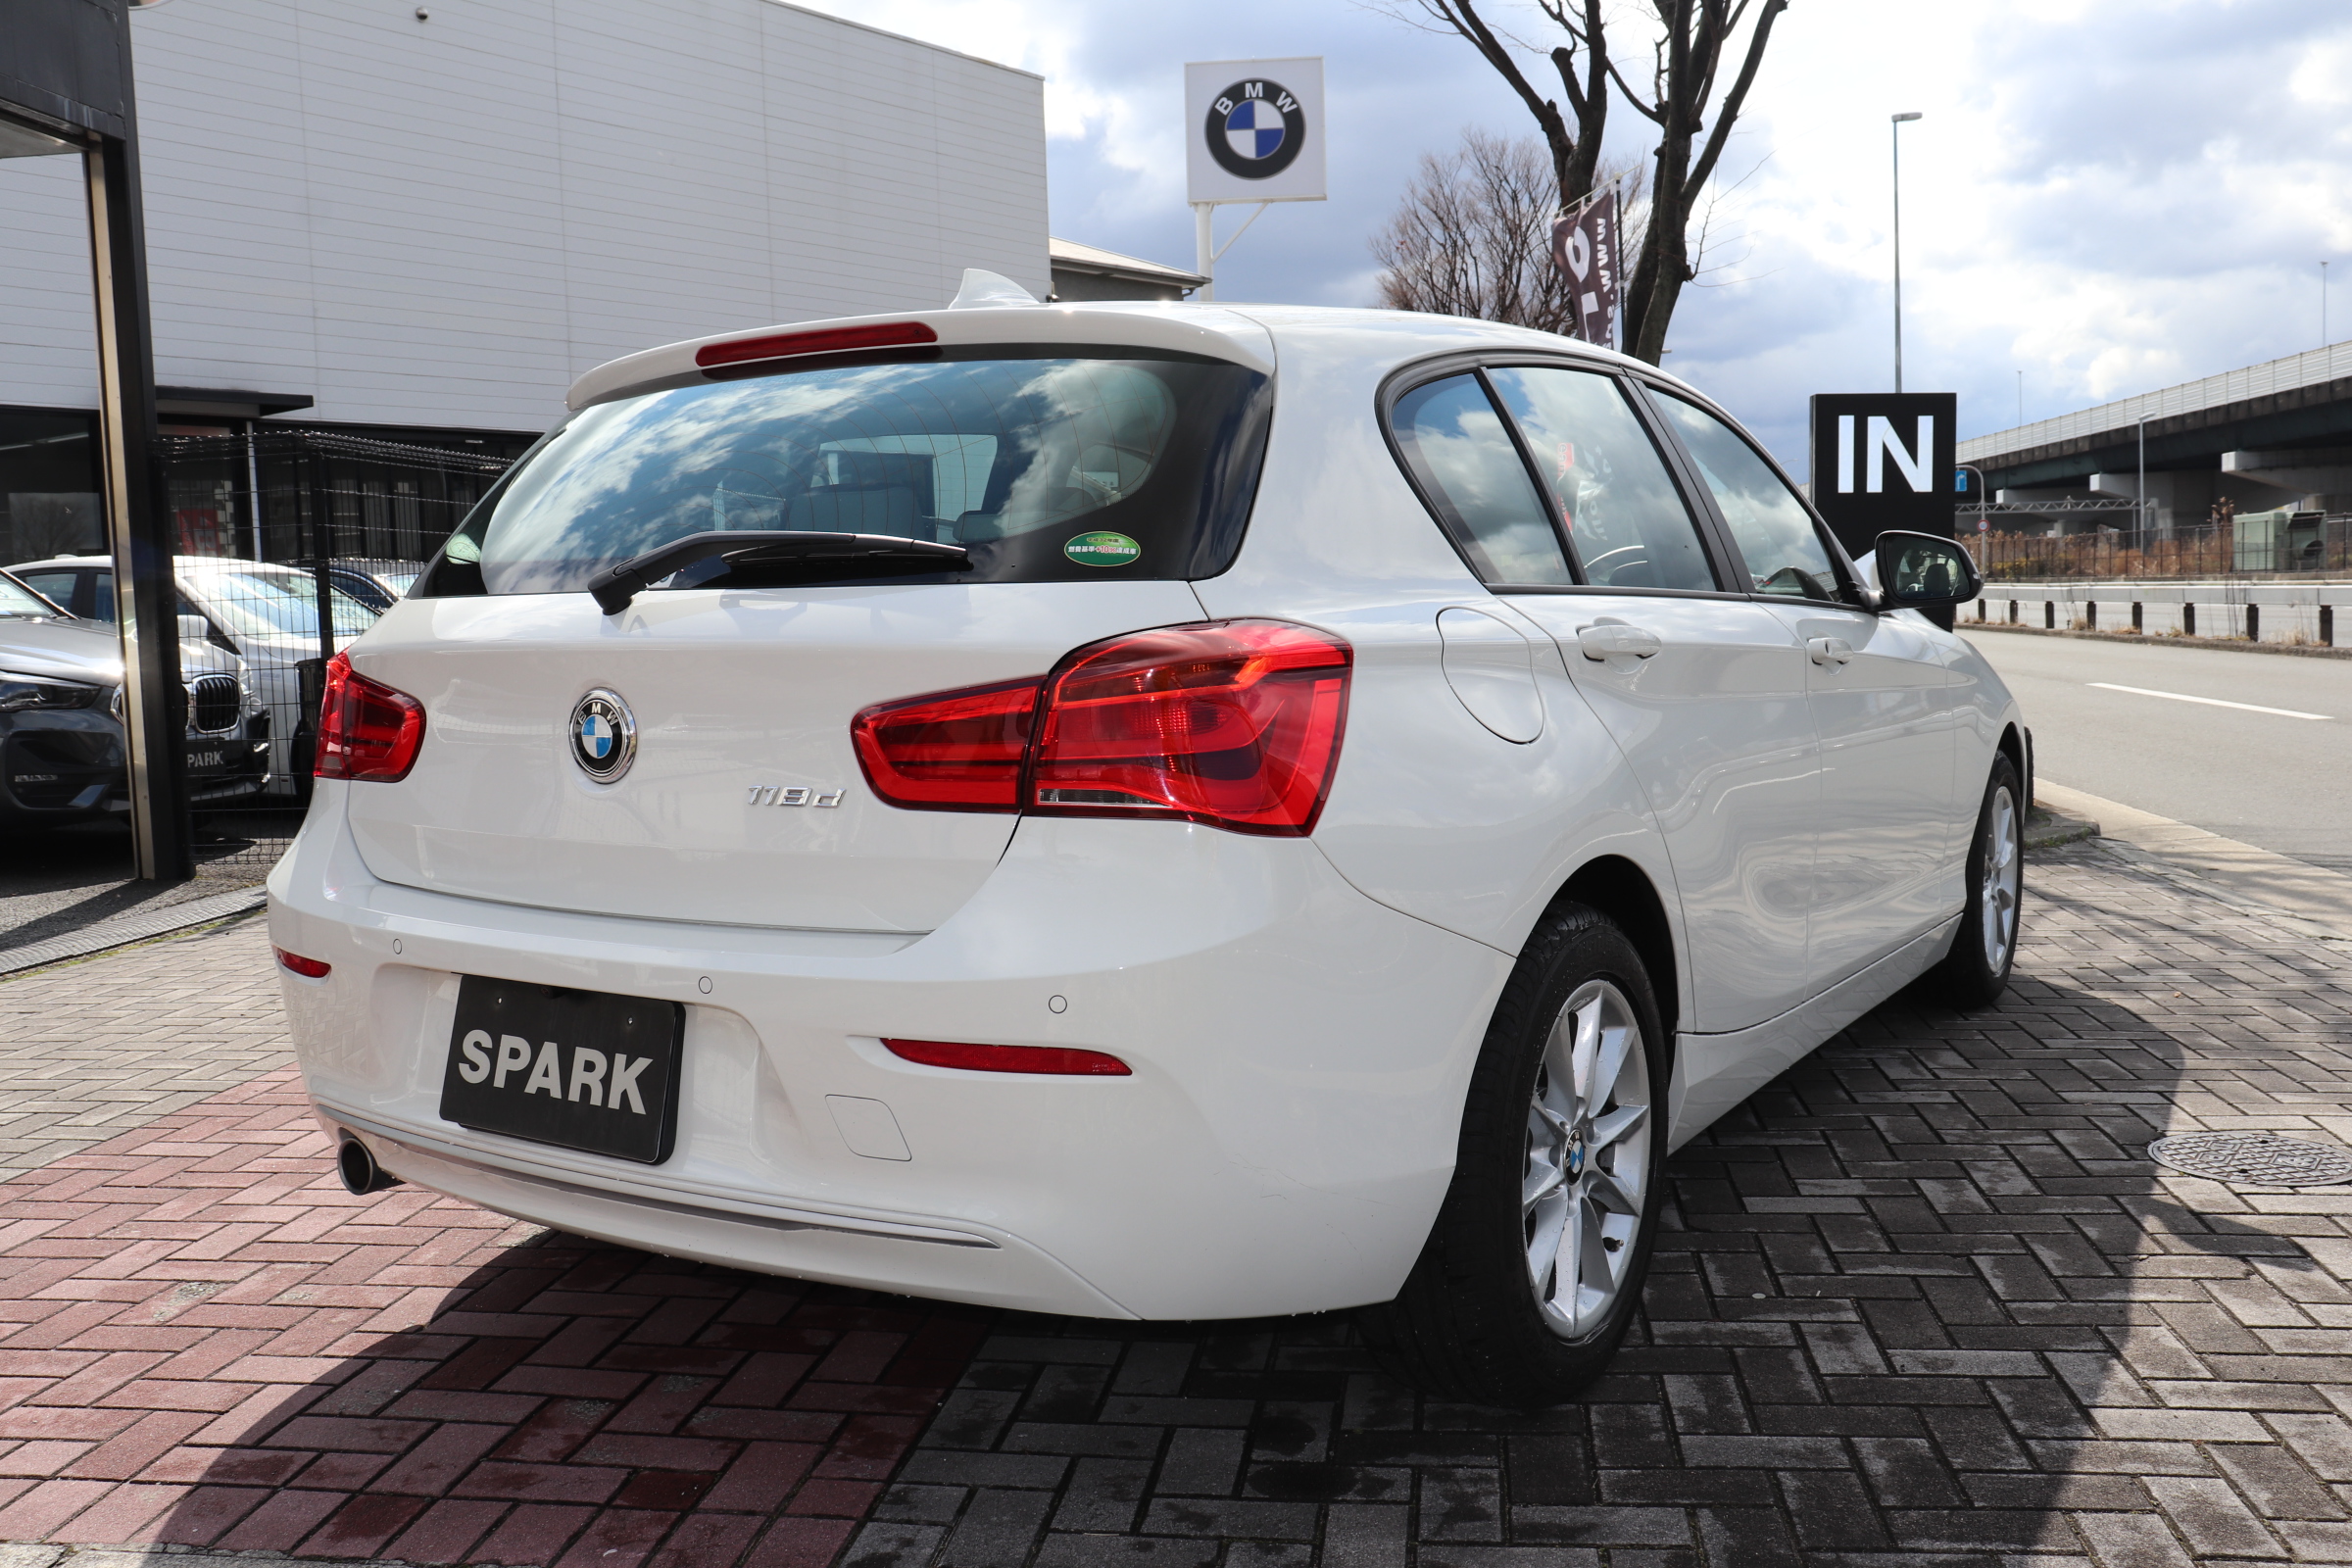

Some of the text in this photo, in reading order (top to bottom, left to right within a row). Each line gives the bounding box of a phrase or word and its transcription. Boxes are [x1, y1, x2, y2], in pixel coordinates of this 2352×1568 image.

[1214, 82, 1298, 116] BMW
[1838, 415, 1935, 493] IN
[577, 702, 618, 726] BMW
[186, 751, 224, 768] PARK
[748, 785, 847, 808] 118d
[458, 1029, 654, 1115] SPARK
